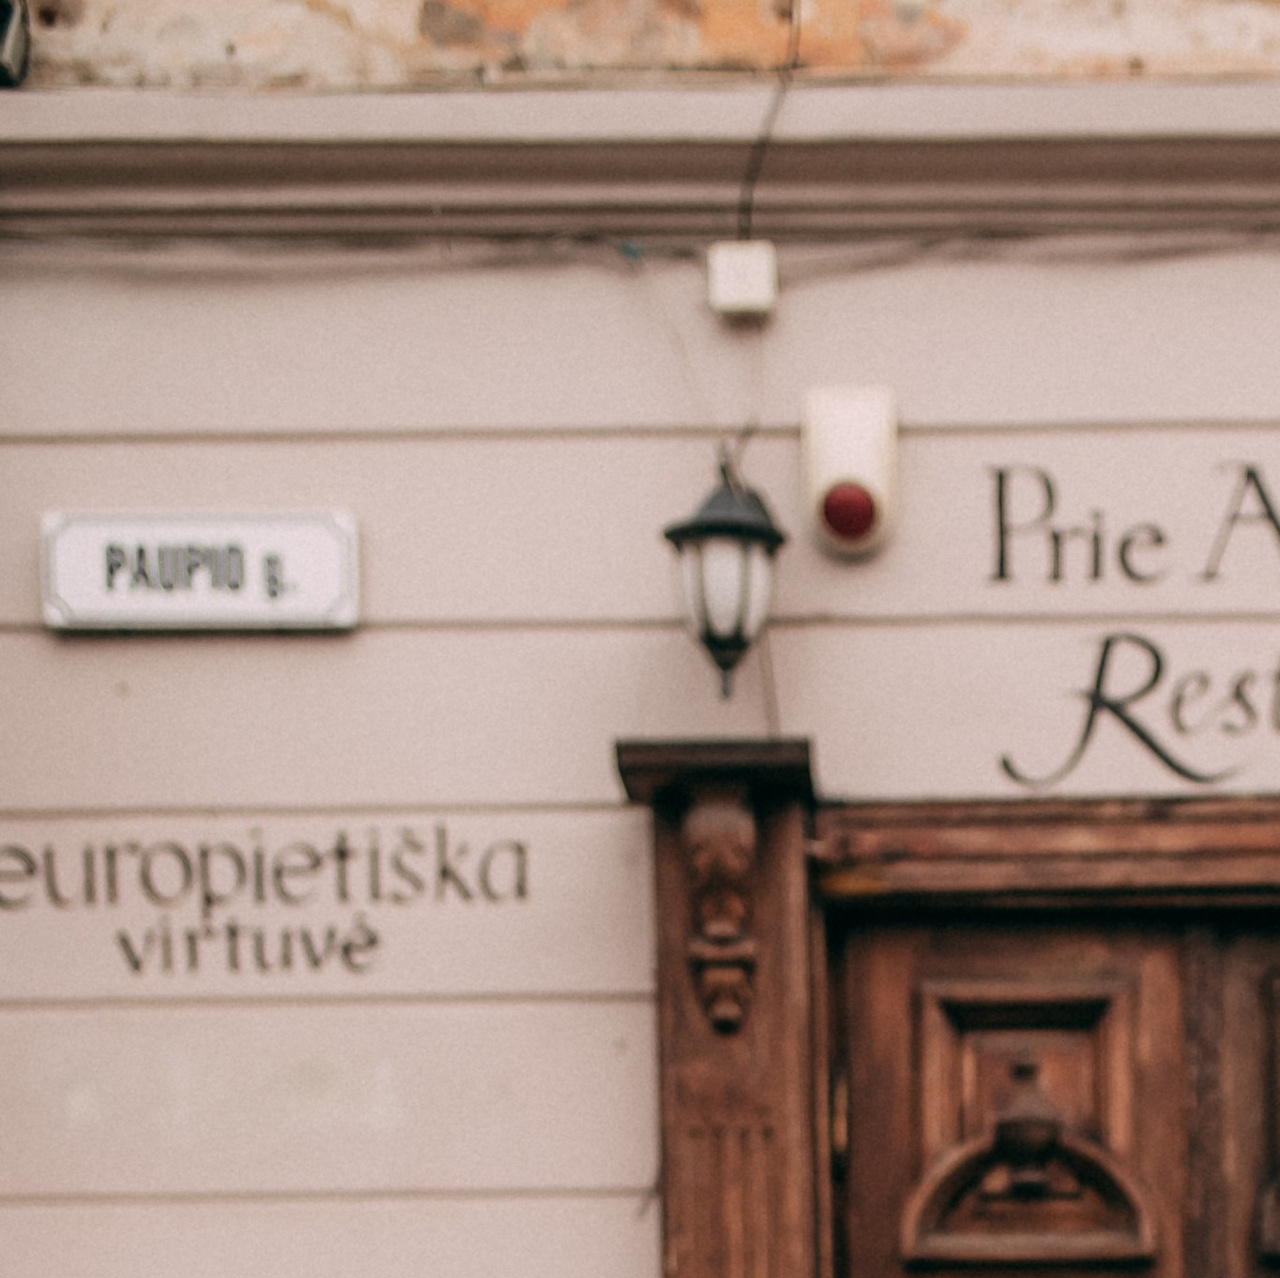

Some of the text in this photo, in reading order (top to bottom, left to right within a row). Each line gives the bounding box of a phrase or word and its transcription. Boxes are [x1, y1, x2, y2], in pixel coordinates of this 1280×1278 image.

[987, 463, 1166, 585] Prie
[105, 546, 244, 591] PAUPIO
[0, 823, 531, 921] europietiška
[116, 907, 380, 974] virtuvė
